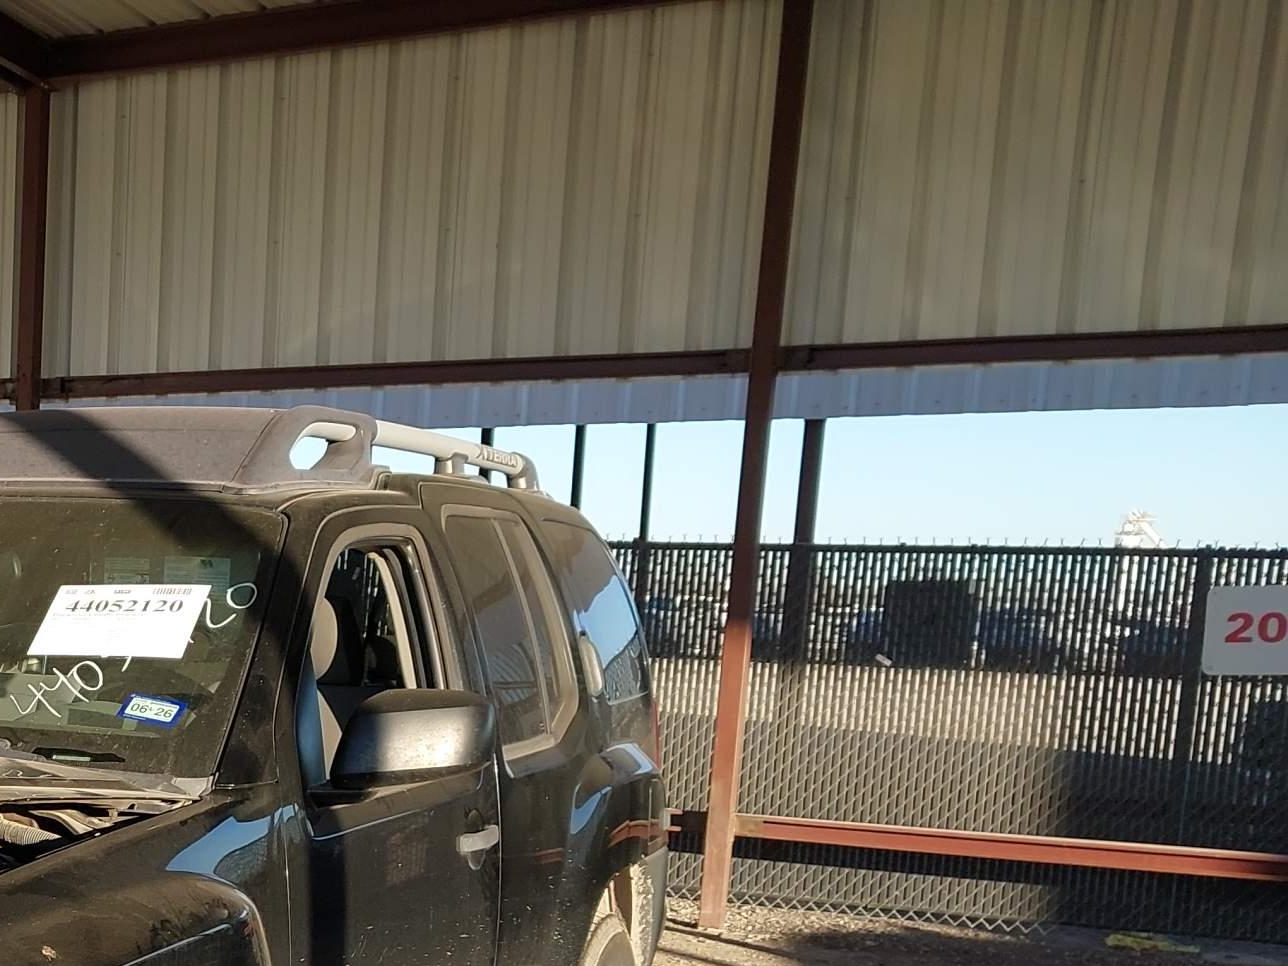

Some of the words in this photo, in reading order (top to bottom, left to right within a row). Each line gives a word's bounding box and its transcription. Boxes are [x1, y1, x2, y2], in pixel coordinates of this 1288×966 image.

[65, 599, 184, 613] 44052120
[1224, 611, 1288, 644] 20
[130, 703, 149, 714] 06
[153, 707, 174, 719] 26
